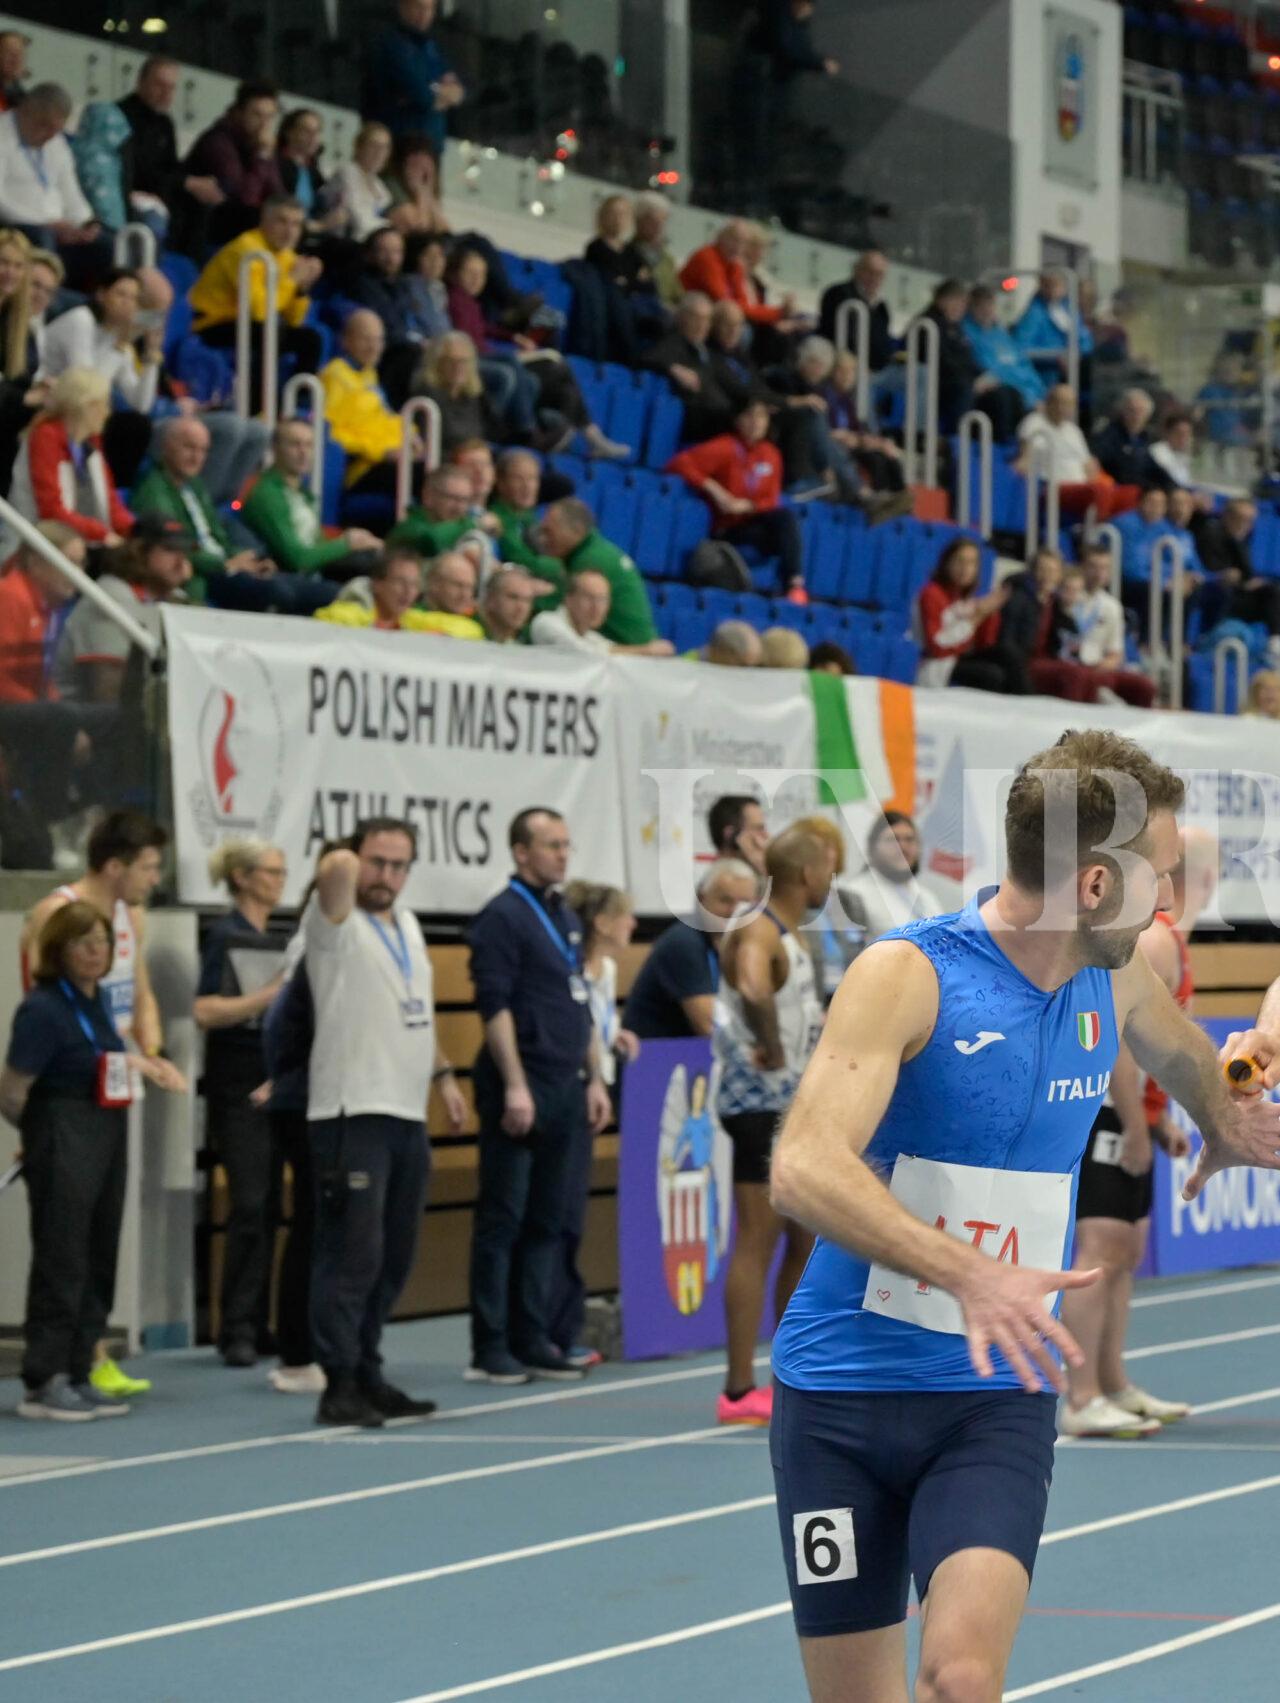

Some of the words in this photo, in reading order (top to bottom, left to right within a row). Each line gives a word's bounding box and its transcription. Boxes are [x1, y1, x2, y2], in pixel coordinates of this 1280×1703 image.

[308, 666, 437, 744] POLISH
[446, 682, 600, 758] MASTERS
[1048, 1070, 1110, 1102] ITALIA
[804, 1517, 841, 1577] 6
